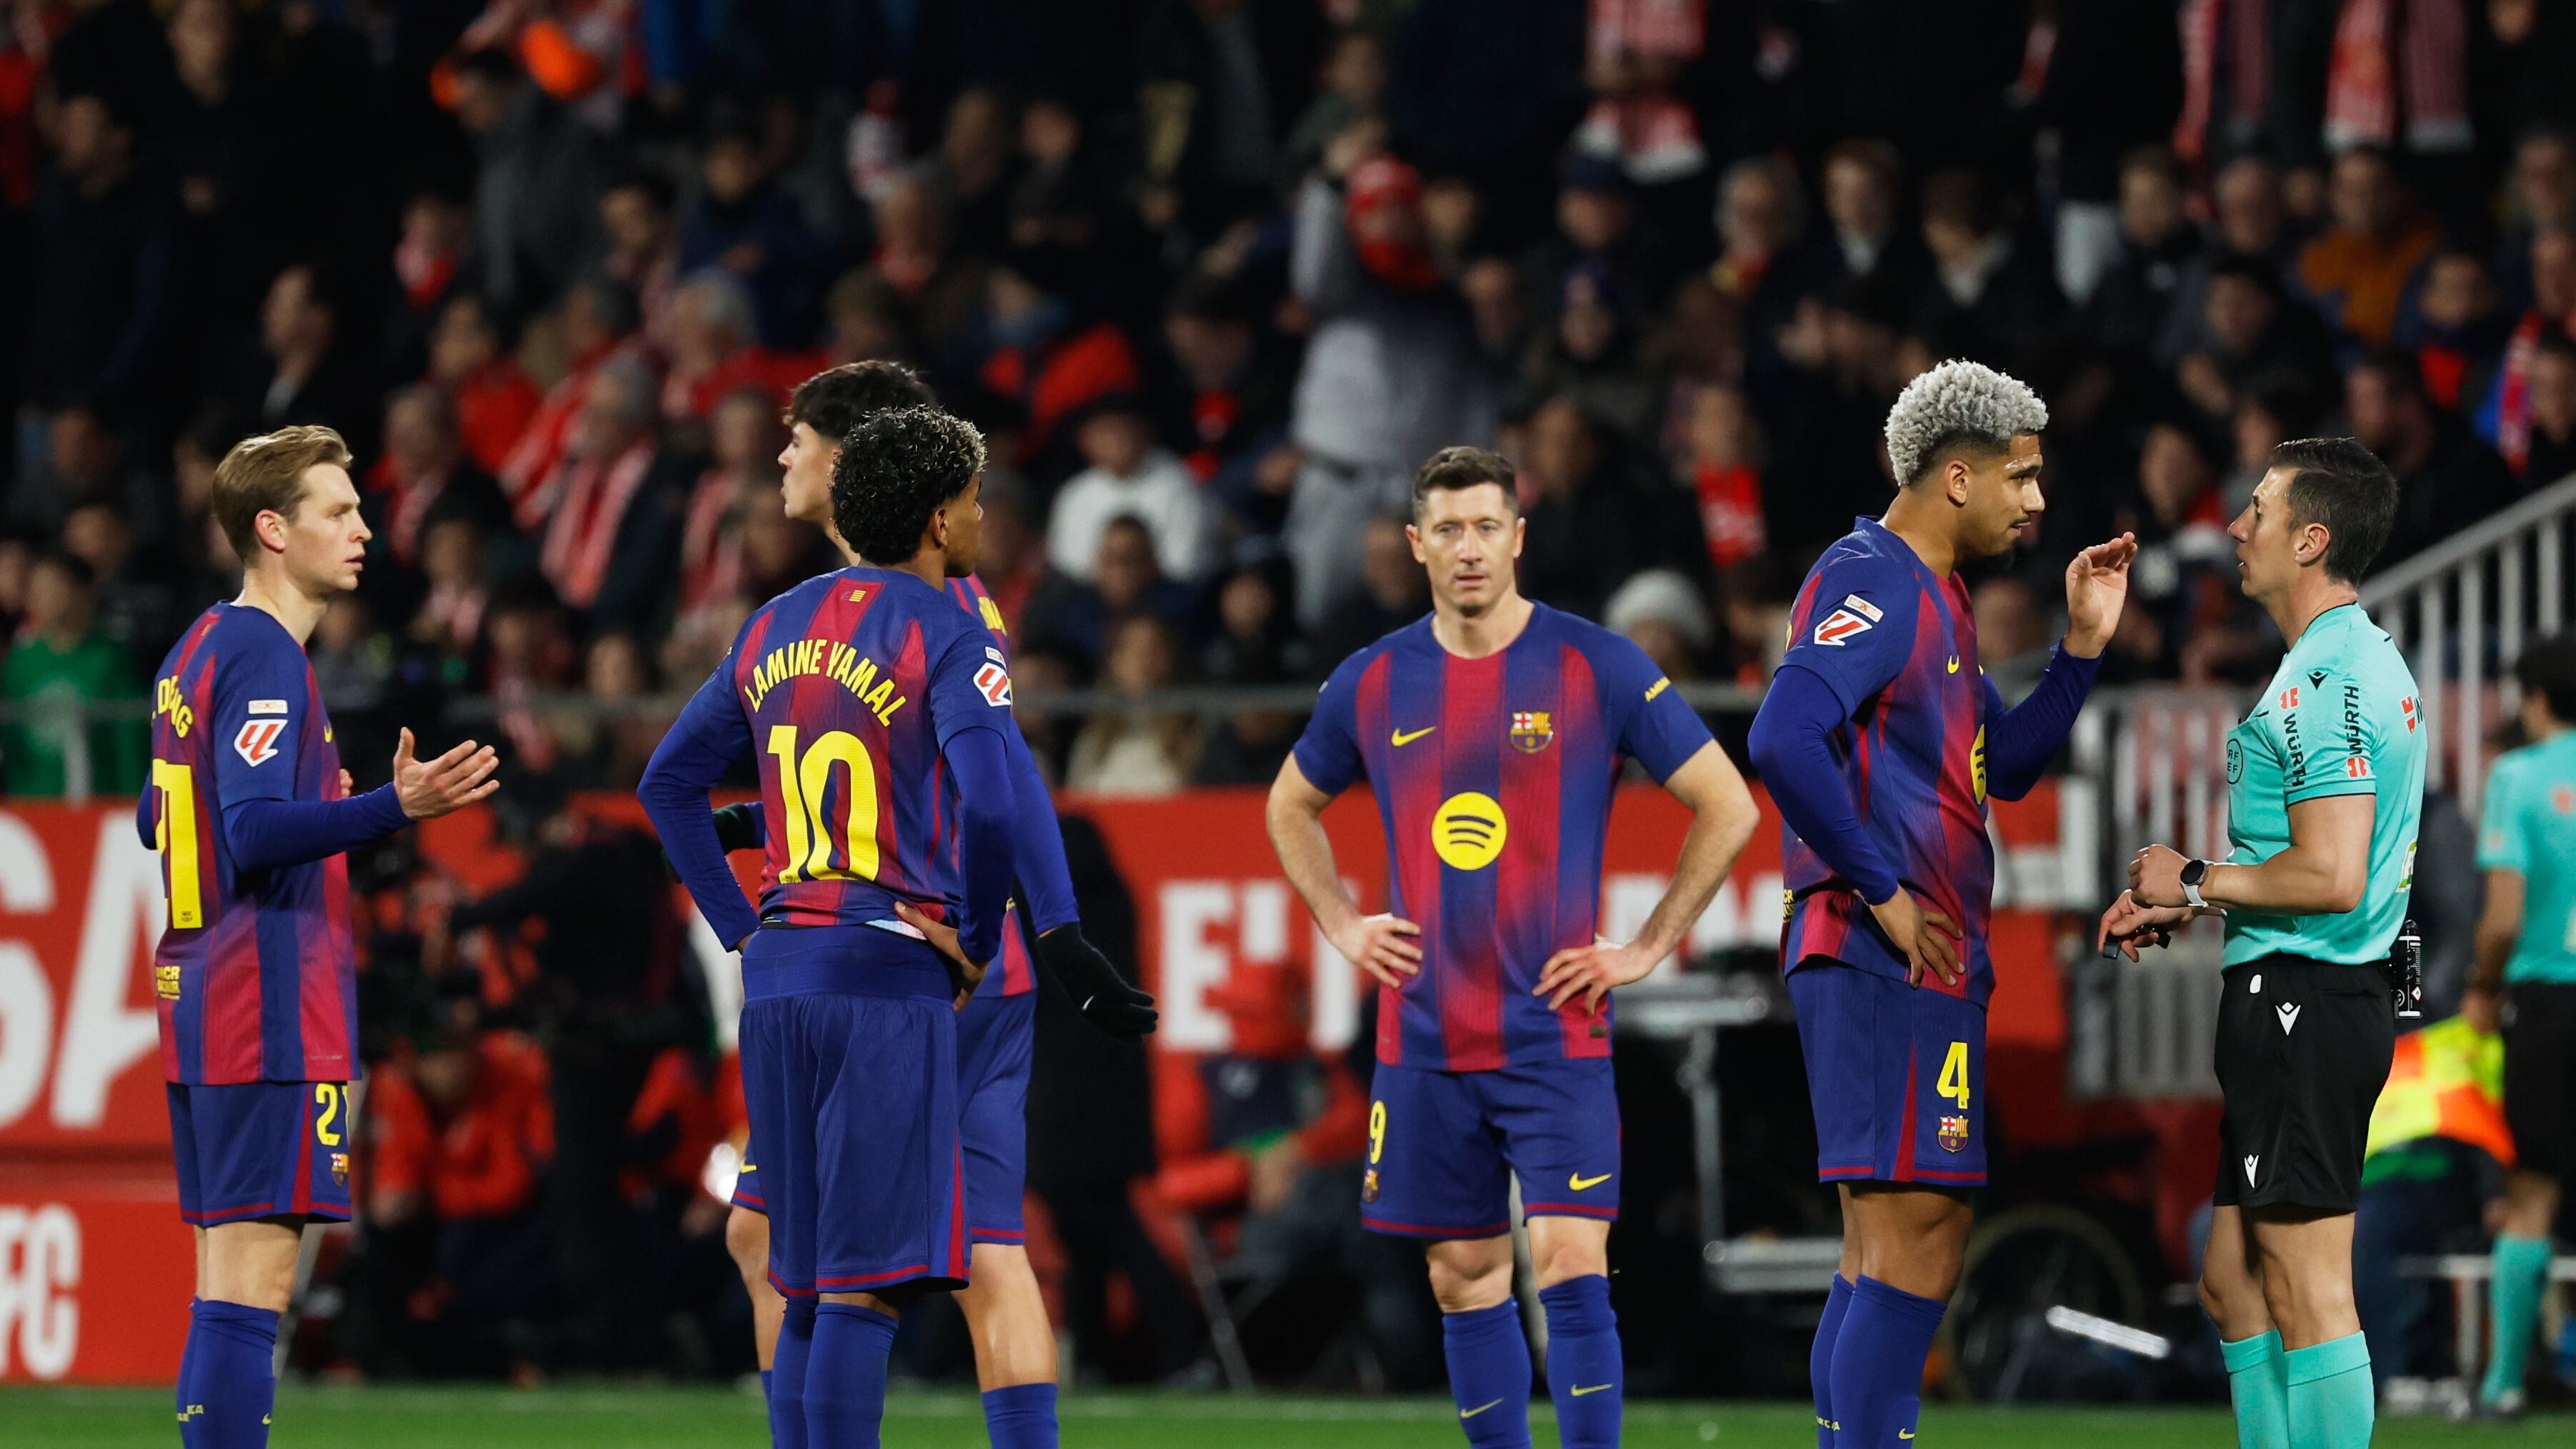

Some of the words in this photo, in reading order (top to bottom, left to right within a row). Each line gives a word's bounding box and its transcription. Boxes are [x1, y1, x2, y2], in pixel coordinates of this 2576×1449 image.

[744, 639, 827, 713] LAMINE
[826, 641, 906, 727] YAMAL
[2284, 713, 2307, 787] WÜRTH
[2344, 685, 2362, 755] WÜRTH
[2227, 762, 2238, 774] EF
[2228, 749, 2239, 761] RF
[767, 724, 879, 883] 10
[1937, 1042, 1970, 1109] 4
[1370, 1100, 1387, 1165] 9
